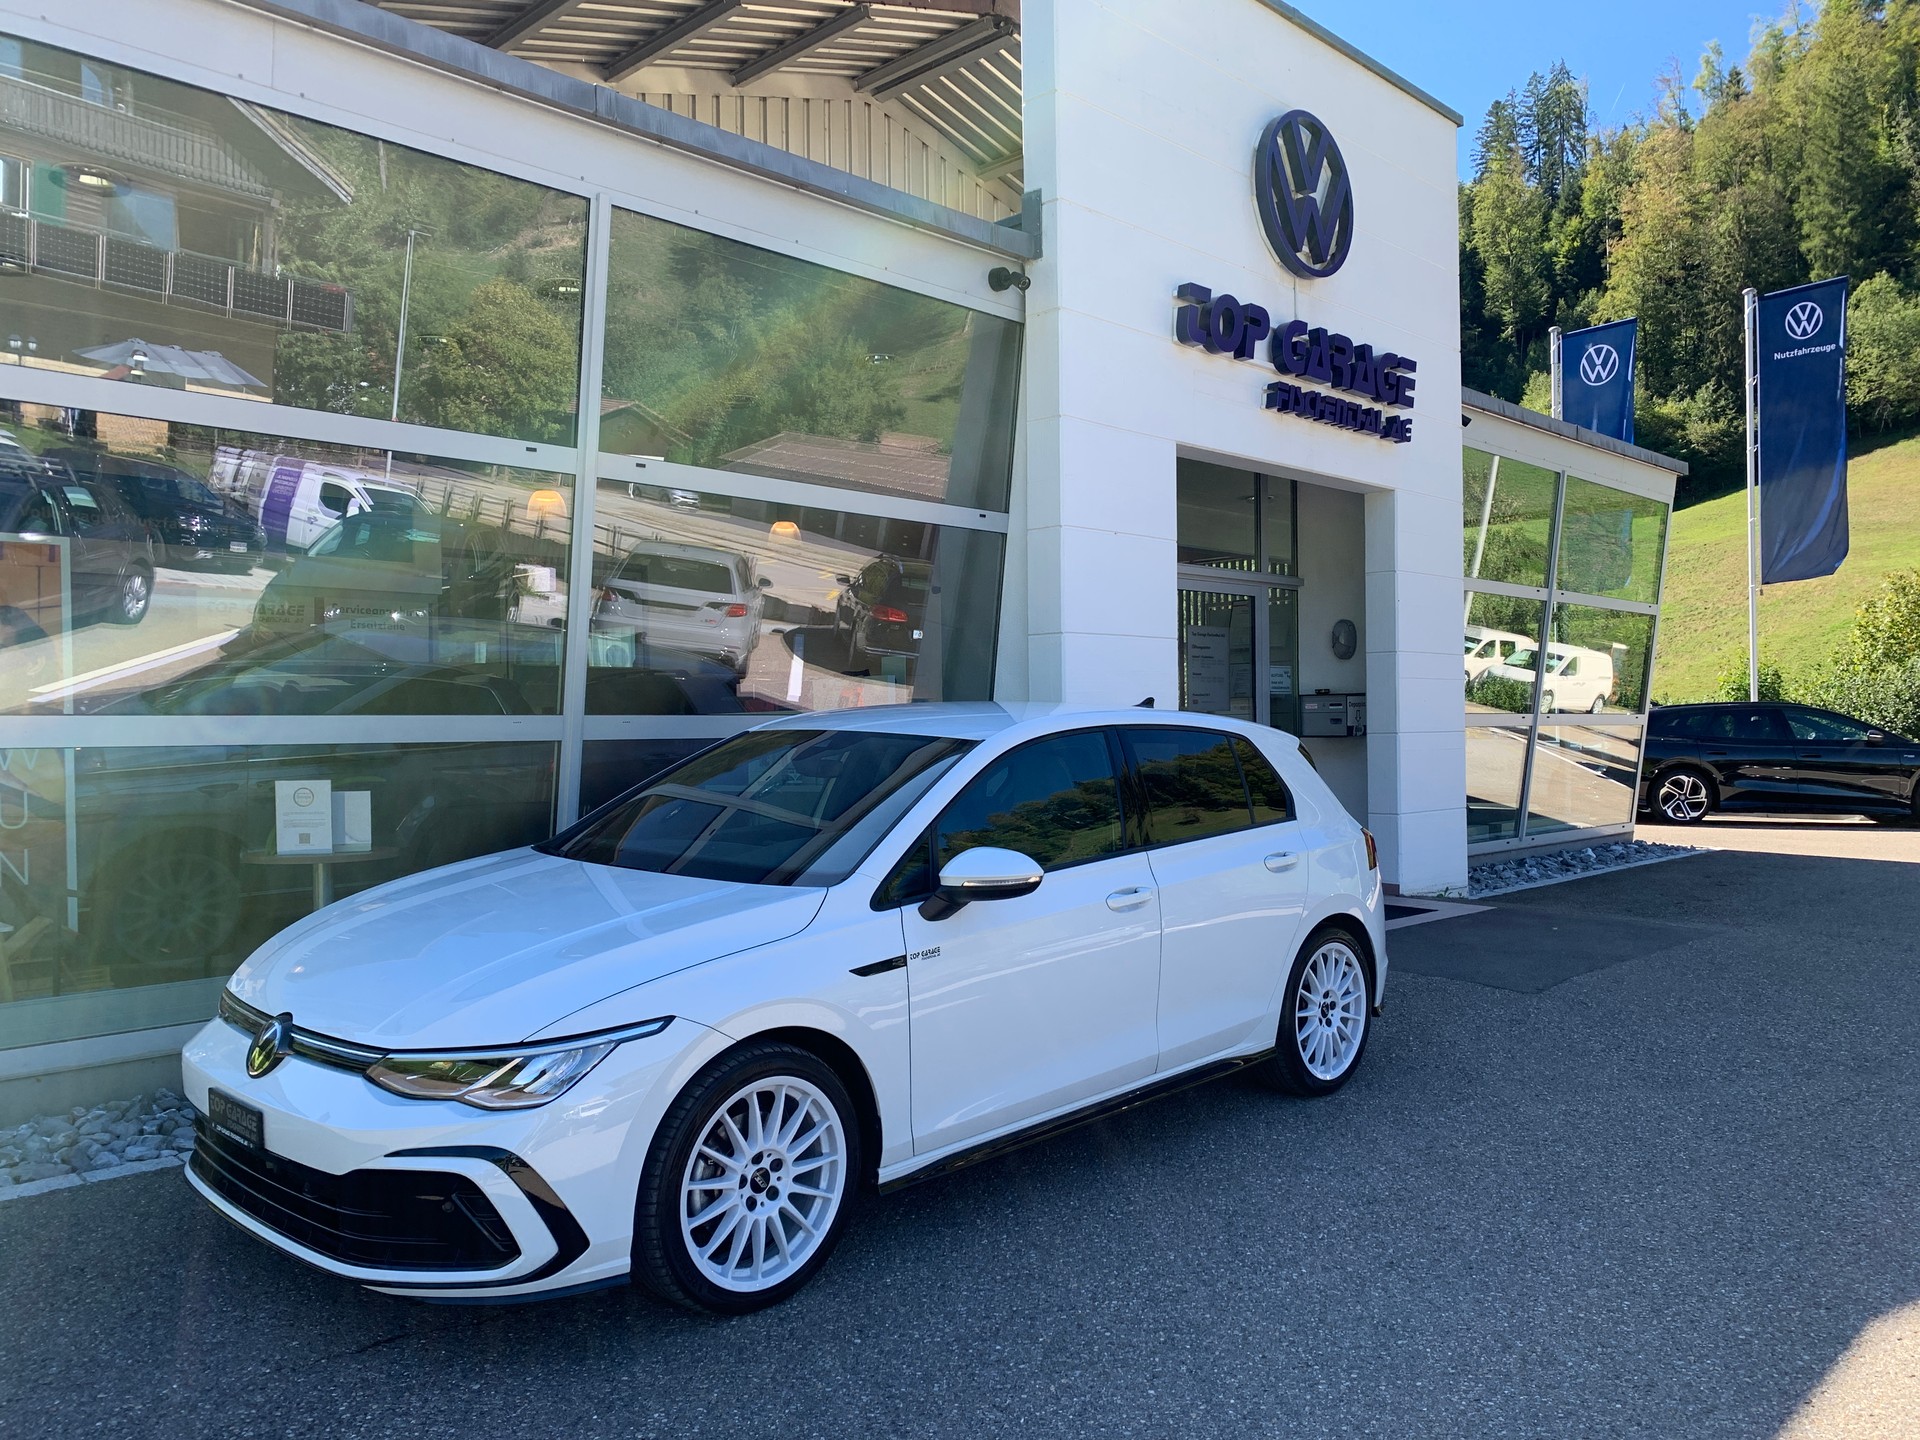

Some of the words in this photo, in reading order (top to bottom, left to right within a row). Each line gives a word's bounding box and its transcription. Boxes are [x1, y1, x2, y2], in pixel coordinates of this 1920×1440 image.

[1177, 282, 1270, 360] TOP
[1272, 320, 1417, 410] GARAGE
[1774, 343, 1836, 360] Nutzfahrzeuge
[1266, 381, 1387, 438] FISCHENTHAL
